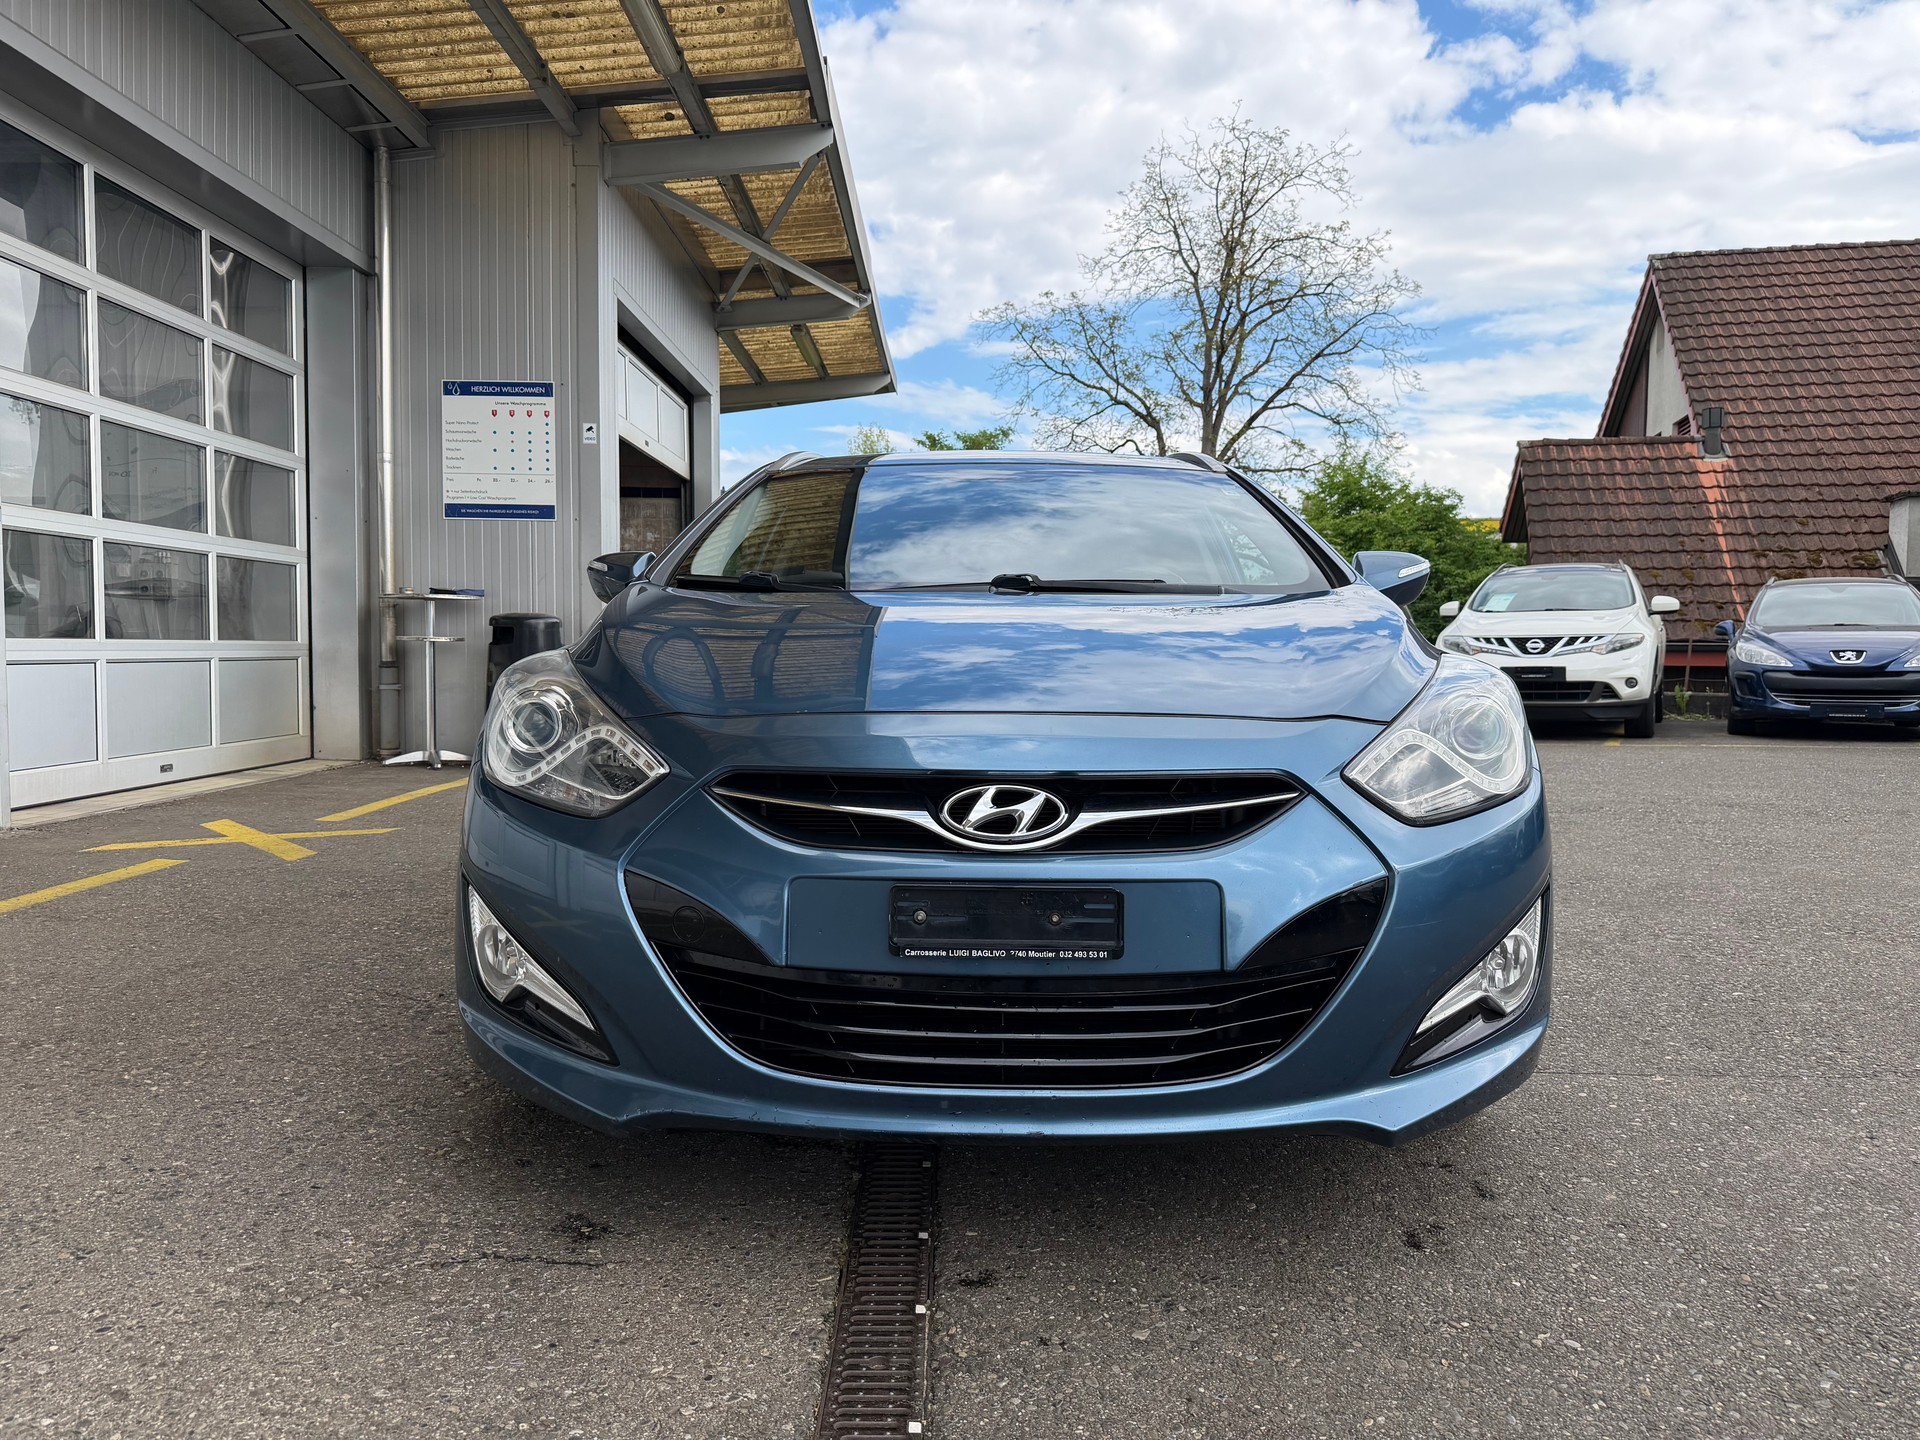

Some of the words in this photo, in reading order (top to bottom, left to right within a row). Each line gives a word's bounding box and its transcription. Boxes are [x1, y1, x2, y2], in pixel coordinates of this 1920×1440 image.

[501, 386, 545, 394] WILLKOMMEN
[904, 948, 947, 957] Carrosserie
[949, 949, 970, 957] LUIGI
[1028, 950, 1056, 958] Moutier
[1073, 950, 1087, 958] 493
[1088, 950, 1098, 958] 53
